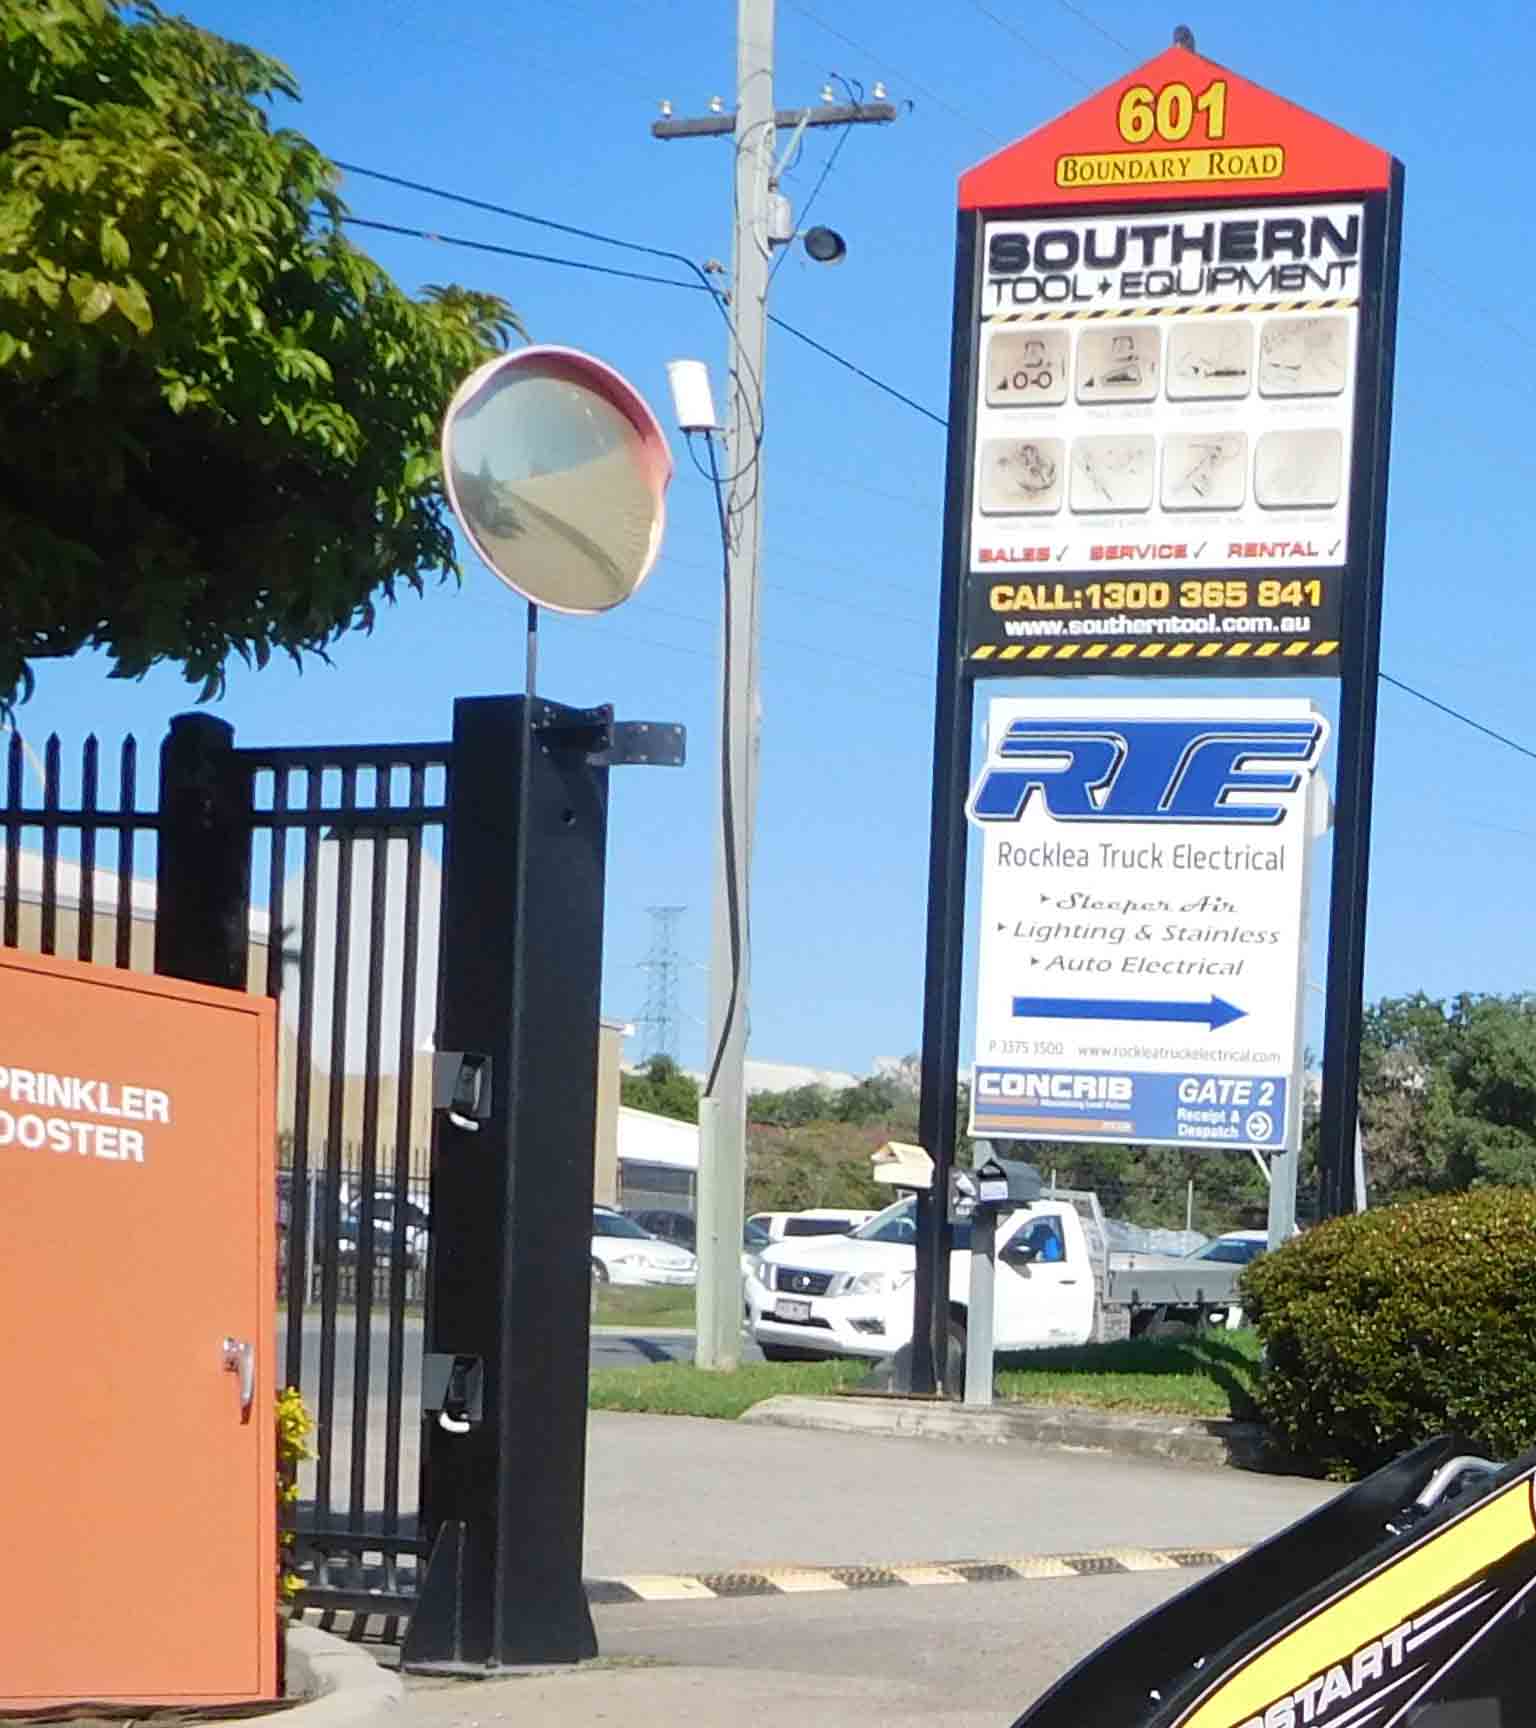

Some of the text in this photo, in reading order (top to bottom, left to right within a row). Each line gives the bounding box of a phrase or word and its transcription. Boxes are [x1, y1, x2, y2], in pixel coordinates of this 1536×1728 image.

[1117, 80, 1227, 143] 601
[1061, 151, 1278, 183] BOUNDARY ROAD
[988, 215, 1360, 274] SOUTHERN
[979, 541, 1318, 563] SALES SERVICE RENTAL
[1180, 580, 1247, 609] 365
[1258, 579, 1322, 608] 841
[1005, 613, 1310, 637] www.southerntool.com.au
[970, 716, 1327, 825] RTE
[998, 841, 1286, 872] Rocklea Truck Electrical
[1055, 891, 1240, 915] Sleeper Air
[1013, 921, 1281, 945] Lighting & Stainless
[1045, 955, 1245, 977] Auto Electrical
[978, 1071, 1134, 1101] CONCRIB
[1178, 1078, 1276, 1107] GATE 2
